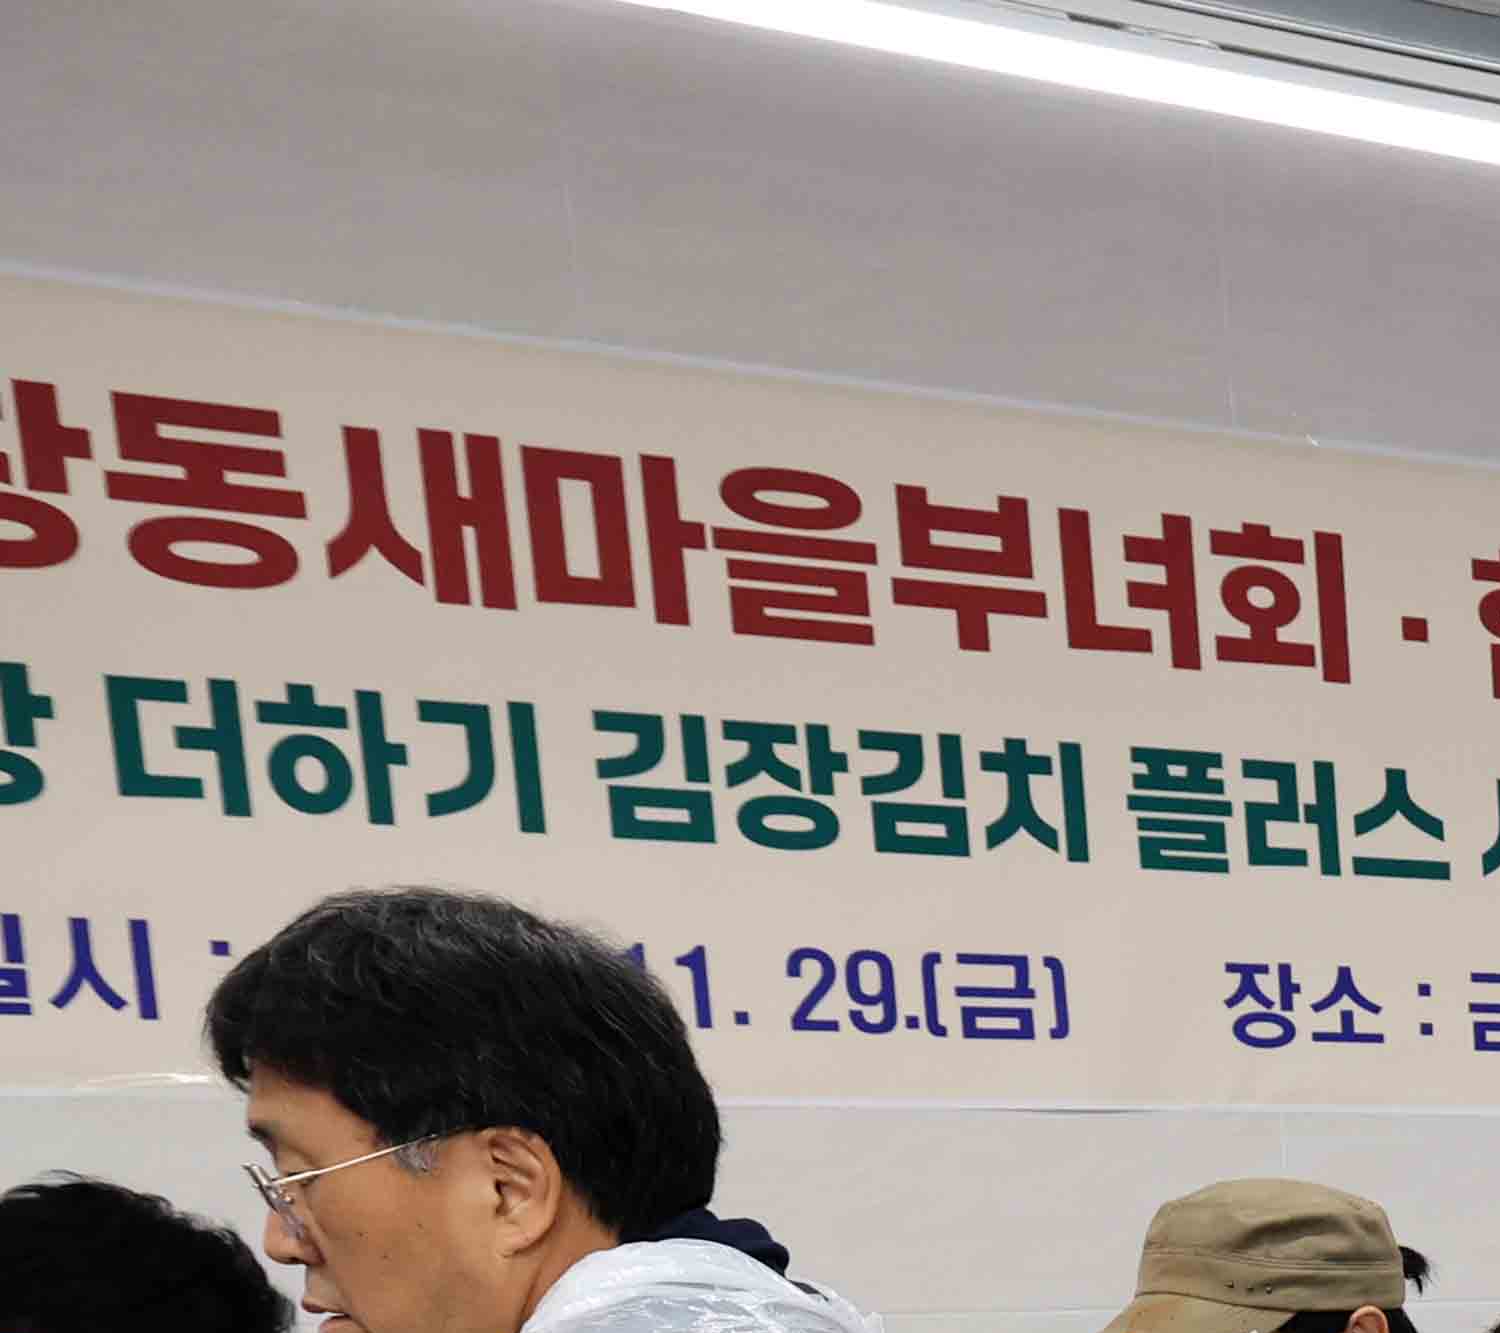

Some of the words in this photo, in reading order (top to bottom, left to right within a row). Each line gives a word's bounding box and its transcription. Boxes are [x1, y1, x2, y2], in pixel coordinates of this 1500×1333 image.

[104, 674, 546, 834] 더하기
[593, 709, 1090, 863] 김장김치
[1126, 746, 1450, 880] 플러스
[630, 943, 750, 1029] 1.
[1224, 962, 1386, 1049] 장소
